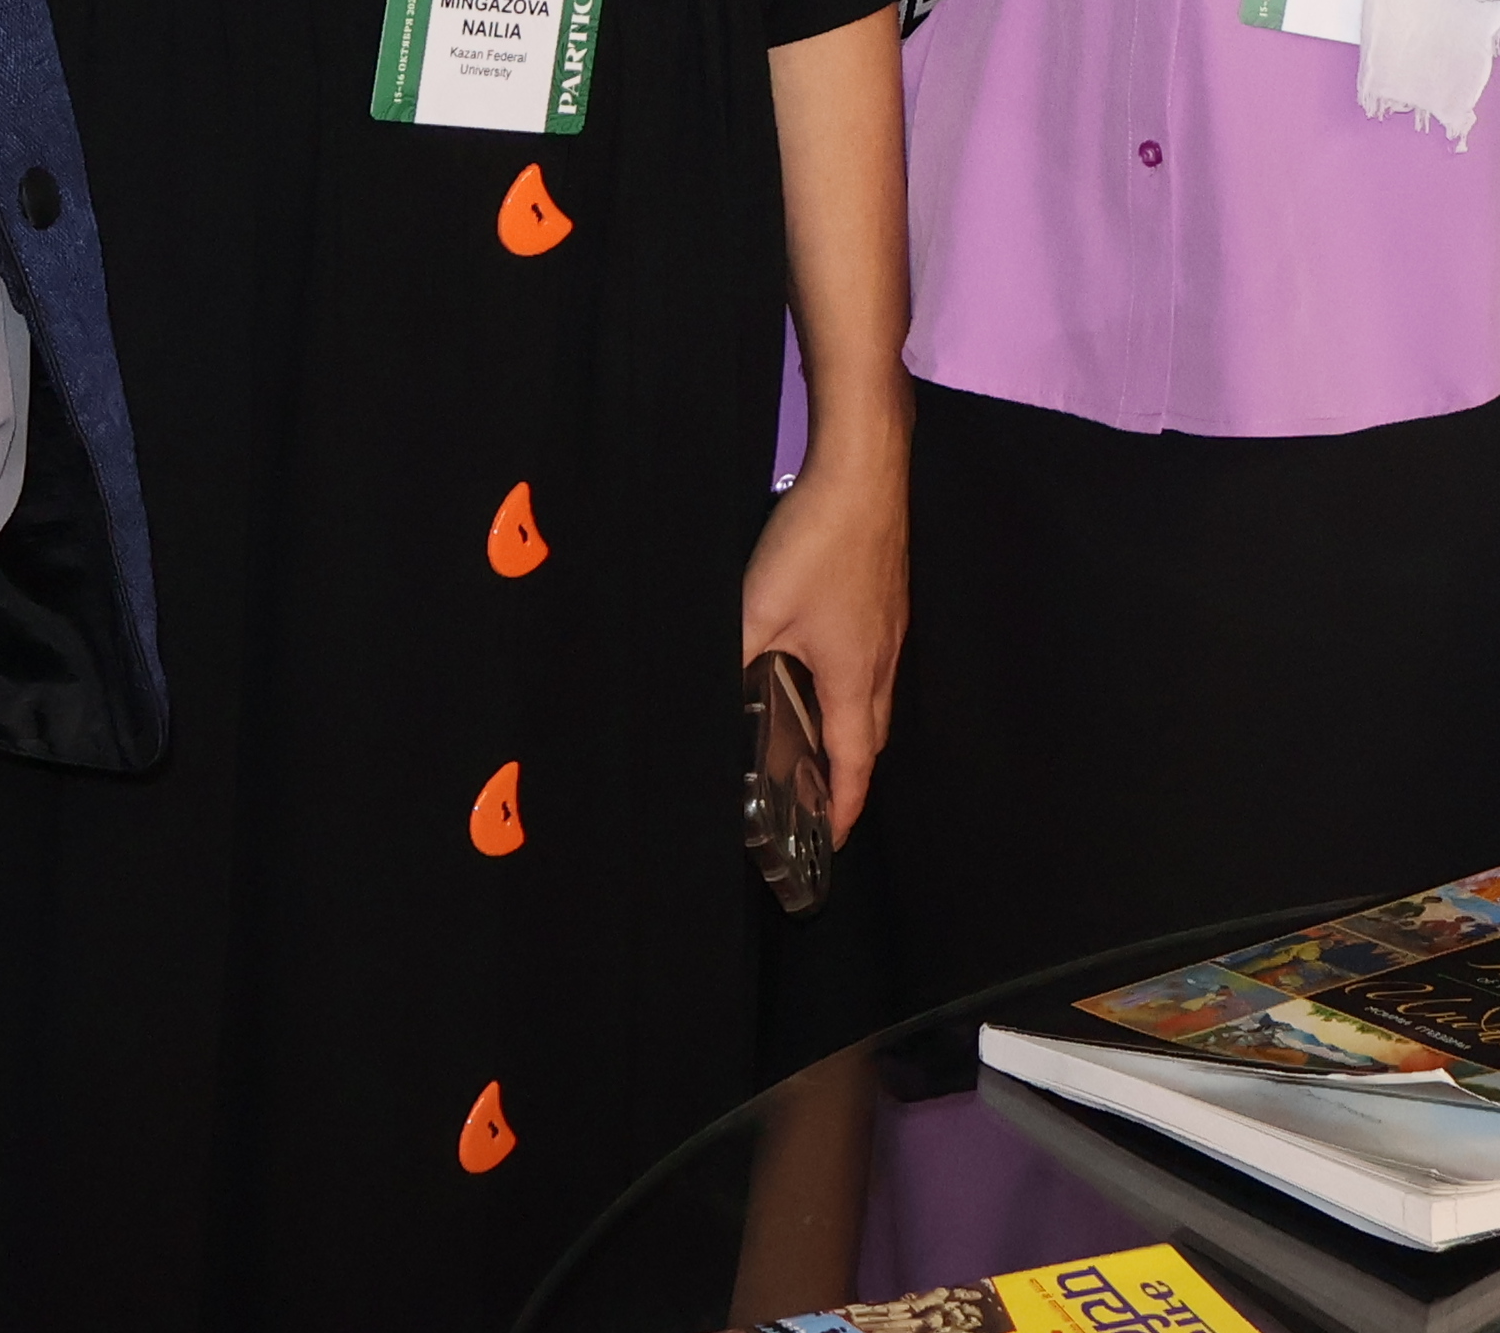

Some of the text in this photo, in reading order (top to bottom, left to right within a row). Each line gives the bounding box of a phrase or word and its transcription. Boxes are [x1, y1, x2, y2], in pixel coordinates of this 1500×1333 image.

[462, 19, 522, 40] NAILIA
[450, 46, 527, 63] Kazan Federal
[460, 64, 512, 80] University
[1056, 1265, 1172, 1333] पर्य
